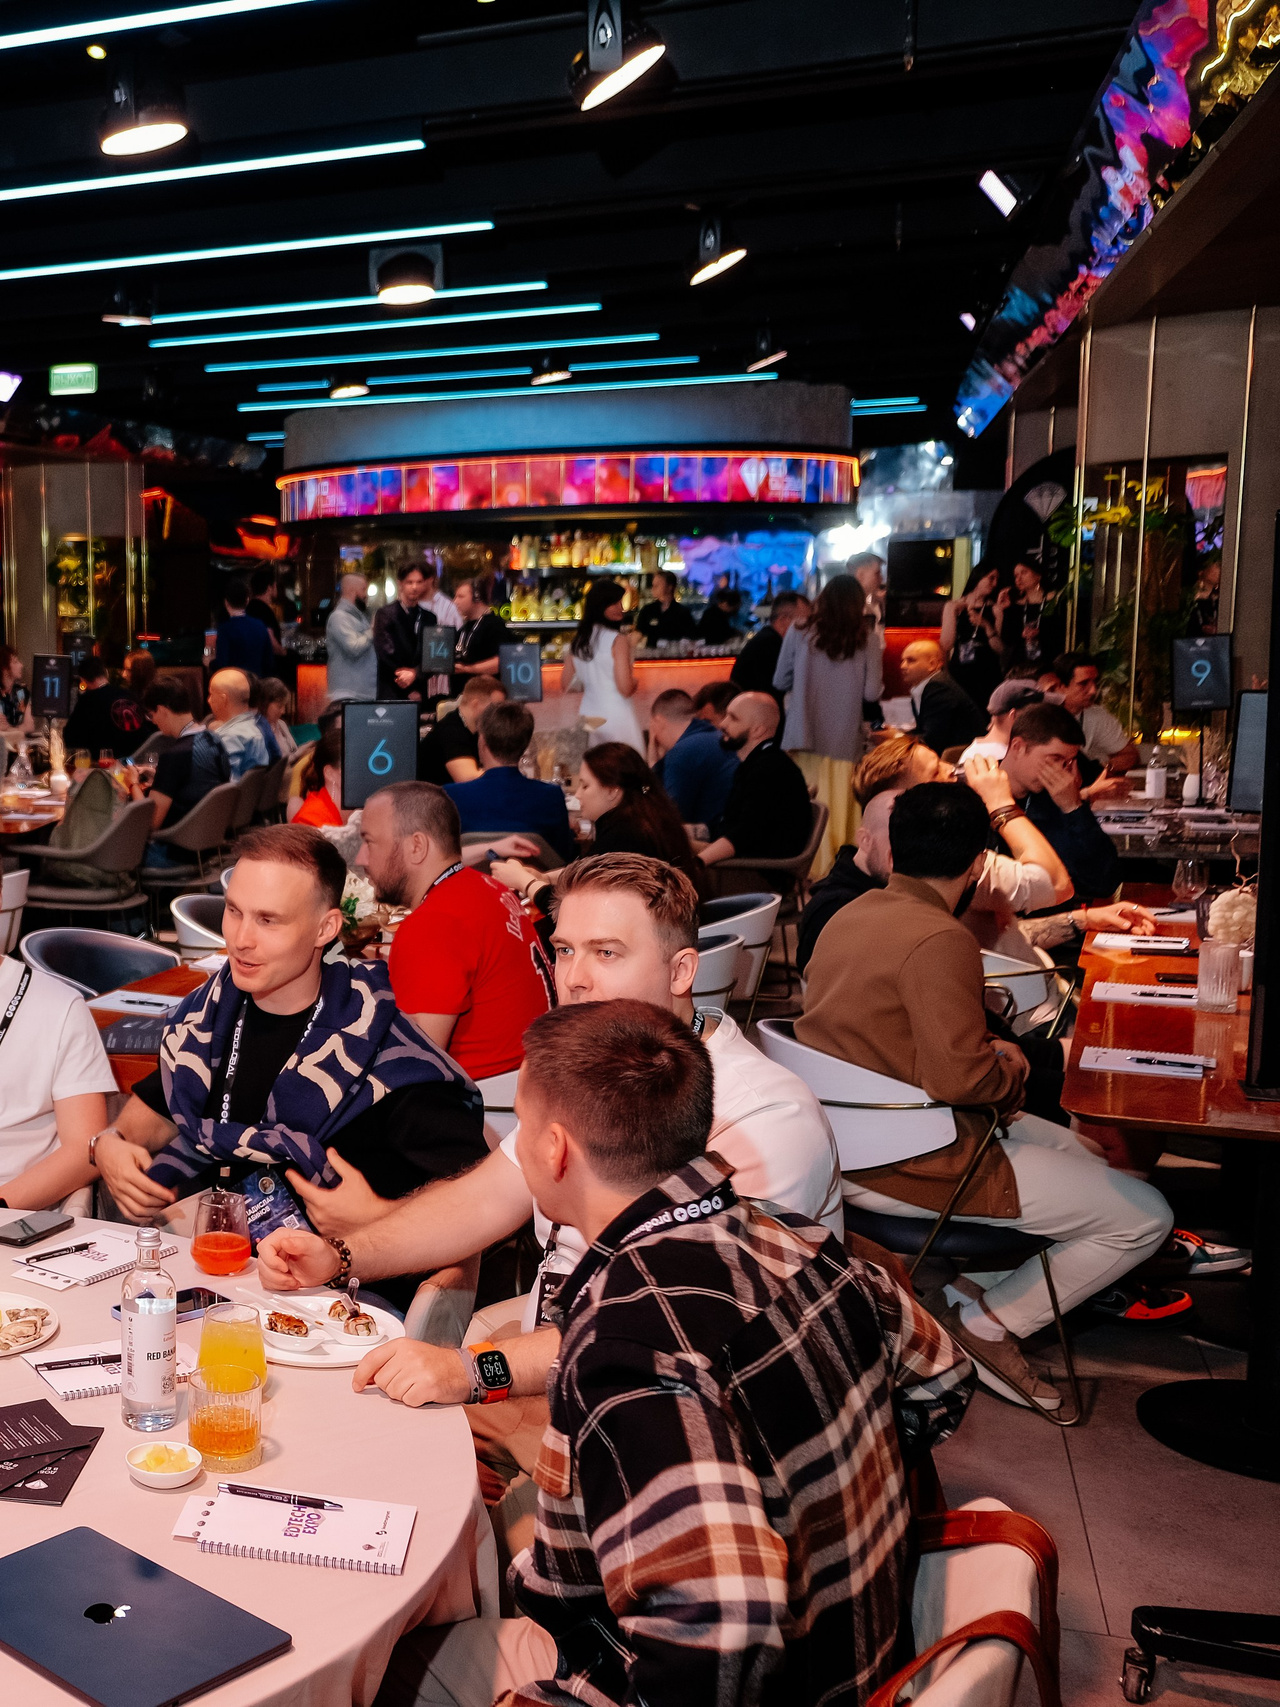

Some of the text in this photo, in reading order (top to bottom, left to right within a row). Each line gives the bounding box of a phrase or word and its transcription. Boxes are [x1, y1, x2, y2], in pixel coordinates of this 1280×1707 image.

[429, 641, 449, 659] 14
[506, 662, 534, 684] 10
[1190, 659, 1212, 687] 9
[43, 676, 61, 698] 11
[367, 738, 393, 776] 6
[225, 1027, 241, 1079] EDGLOBAL
[146, 1351, 161, 1361] RED
[283, 1504, 308, 1538] EDTECH
[301, 1512, 322, 1536] EXPO
